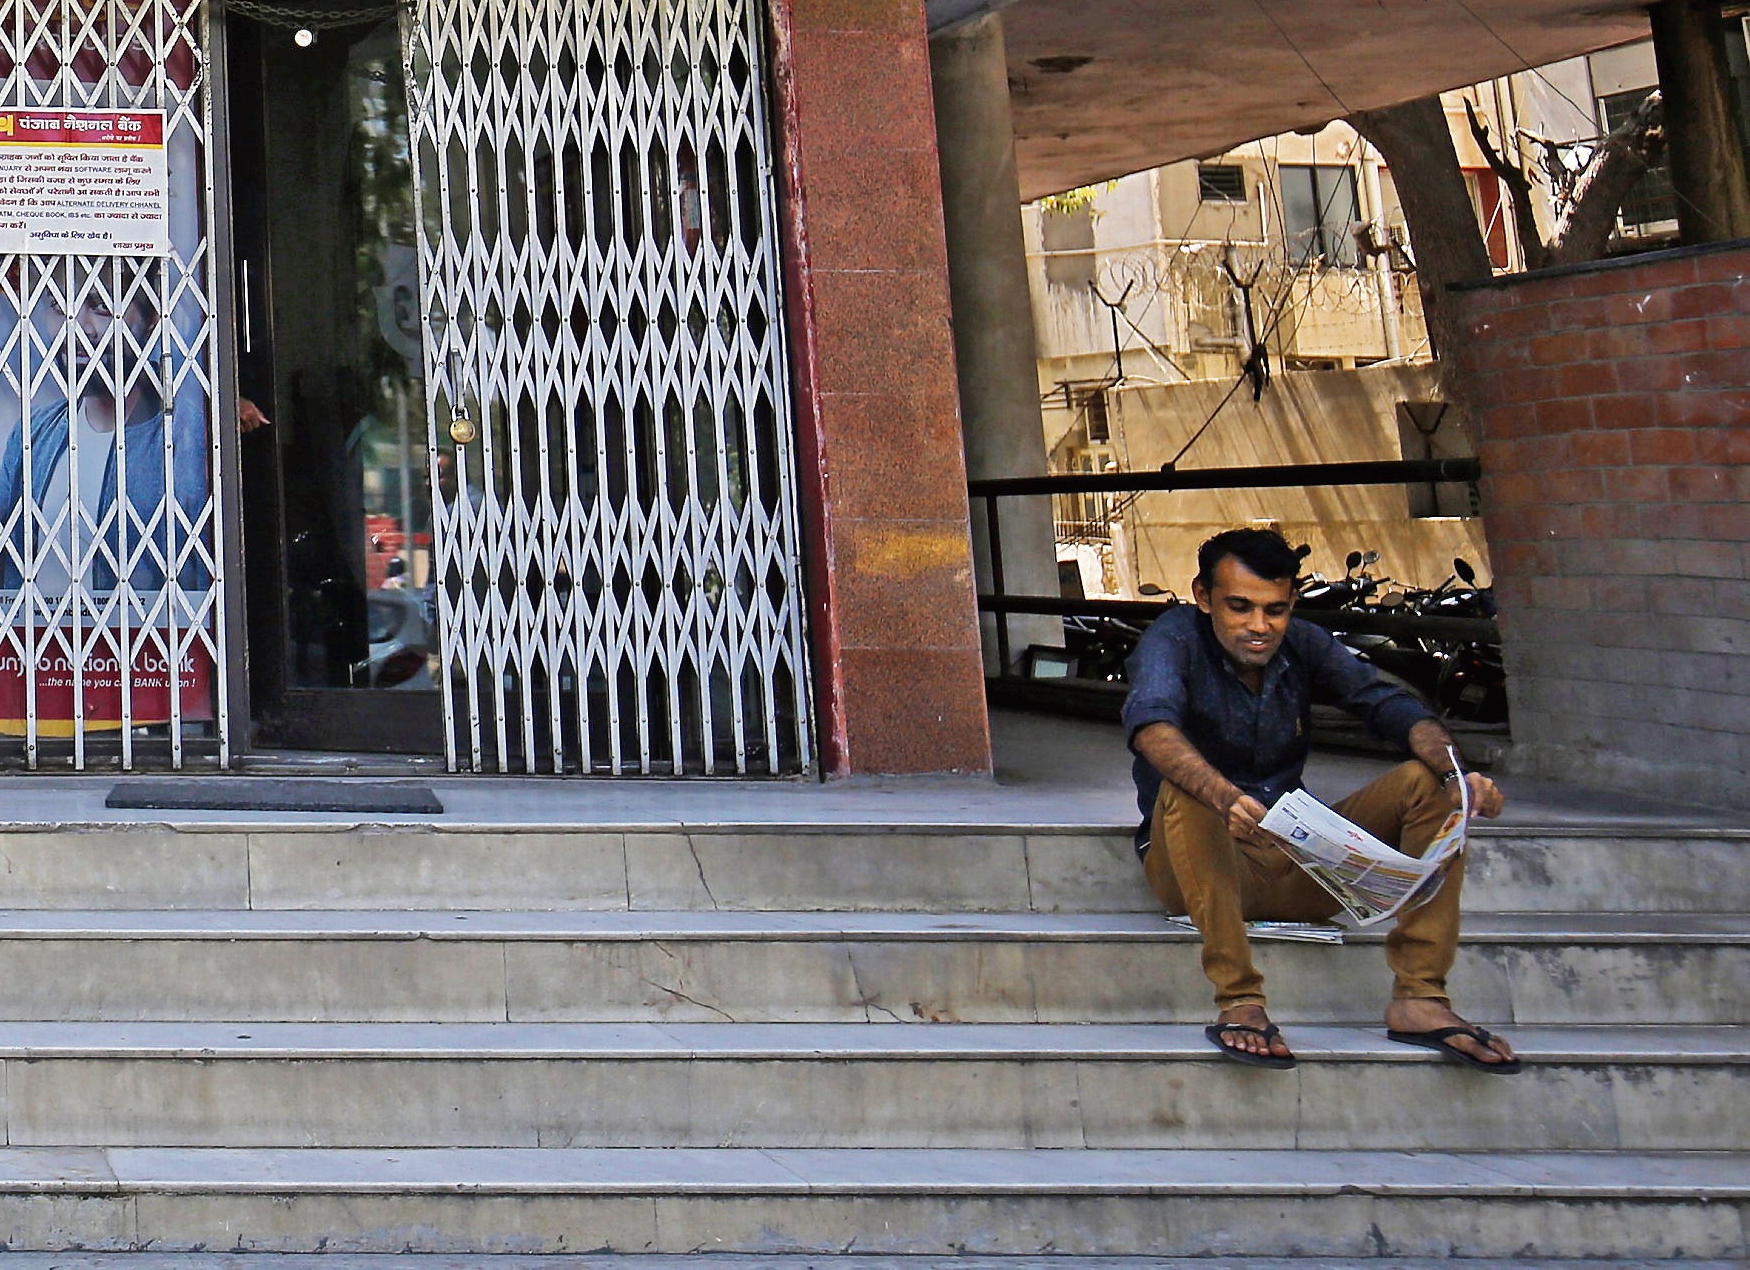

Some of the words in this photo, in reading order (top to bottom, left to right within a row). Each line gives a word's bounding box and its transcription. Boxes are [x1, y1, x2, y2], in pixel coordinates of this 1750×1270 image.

[18, 115, 60, 130] पंजाब
[117, 115, 142, 131] बैंक
[93, 679, 112, 689] you
